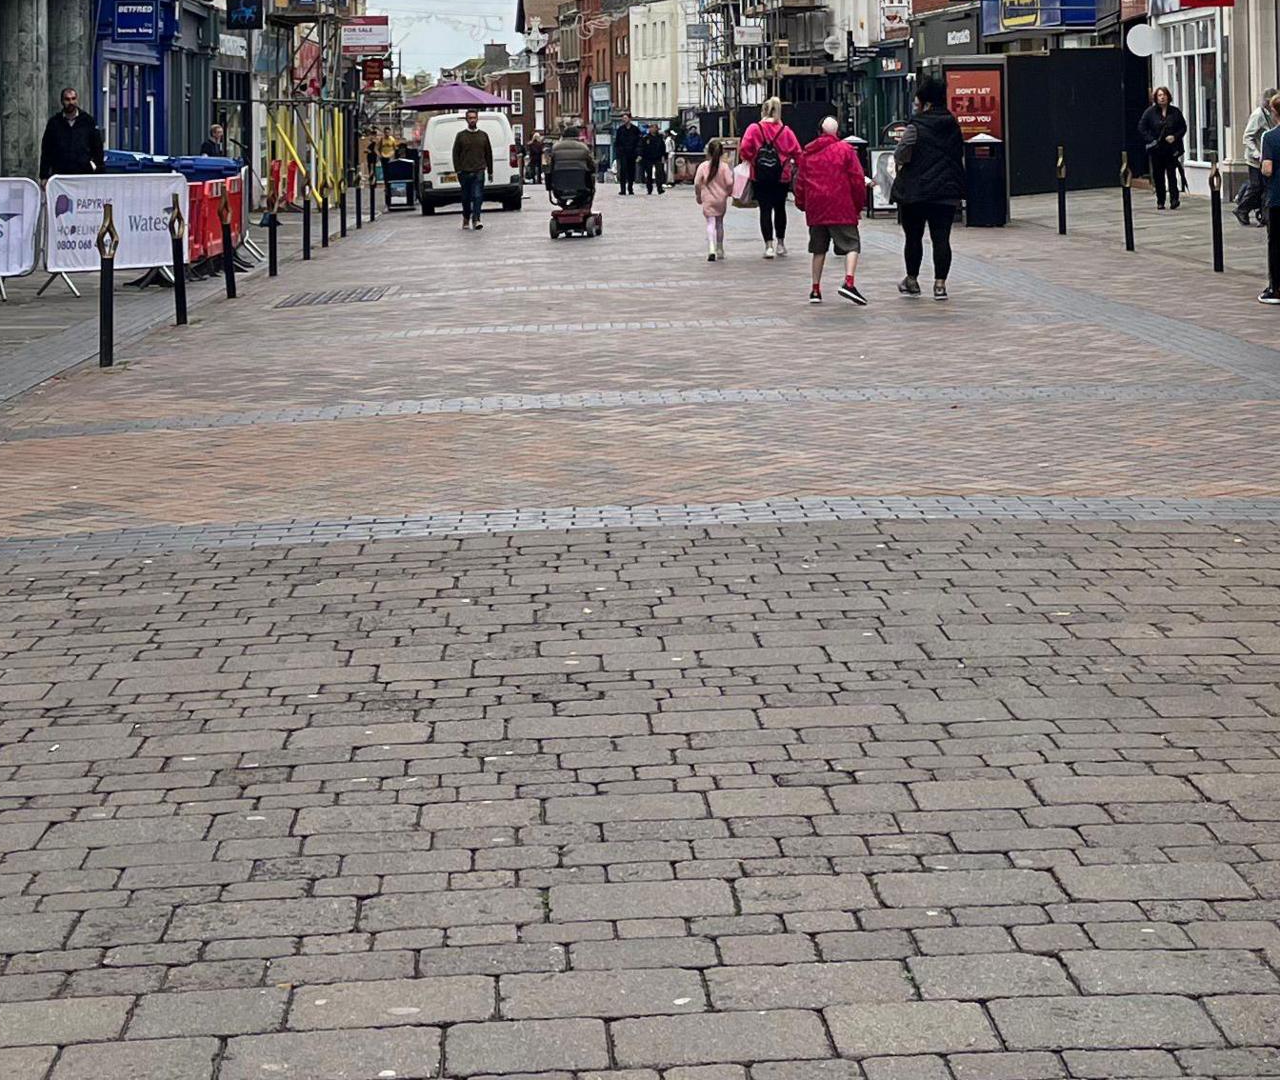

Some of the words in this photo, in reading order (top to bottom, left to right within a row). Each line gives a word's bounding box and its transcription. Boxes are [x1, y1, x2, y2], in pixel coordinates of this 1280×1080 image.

[118, 5, 153, 13] BETFRED
[955, 87, 977, 95] DON'T
[951, 96, 995, 112] FLU
[957, 115, 976, 123] STOP
[976, 115, 992, 123] YOU
[128, 215, 169, 232] Wates
[57, 241, 77, 251] 0800
[78, 240, 92, 250] 068
